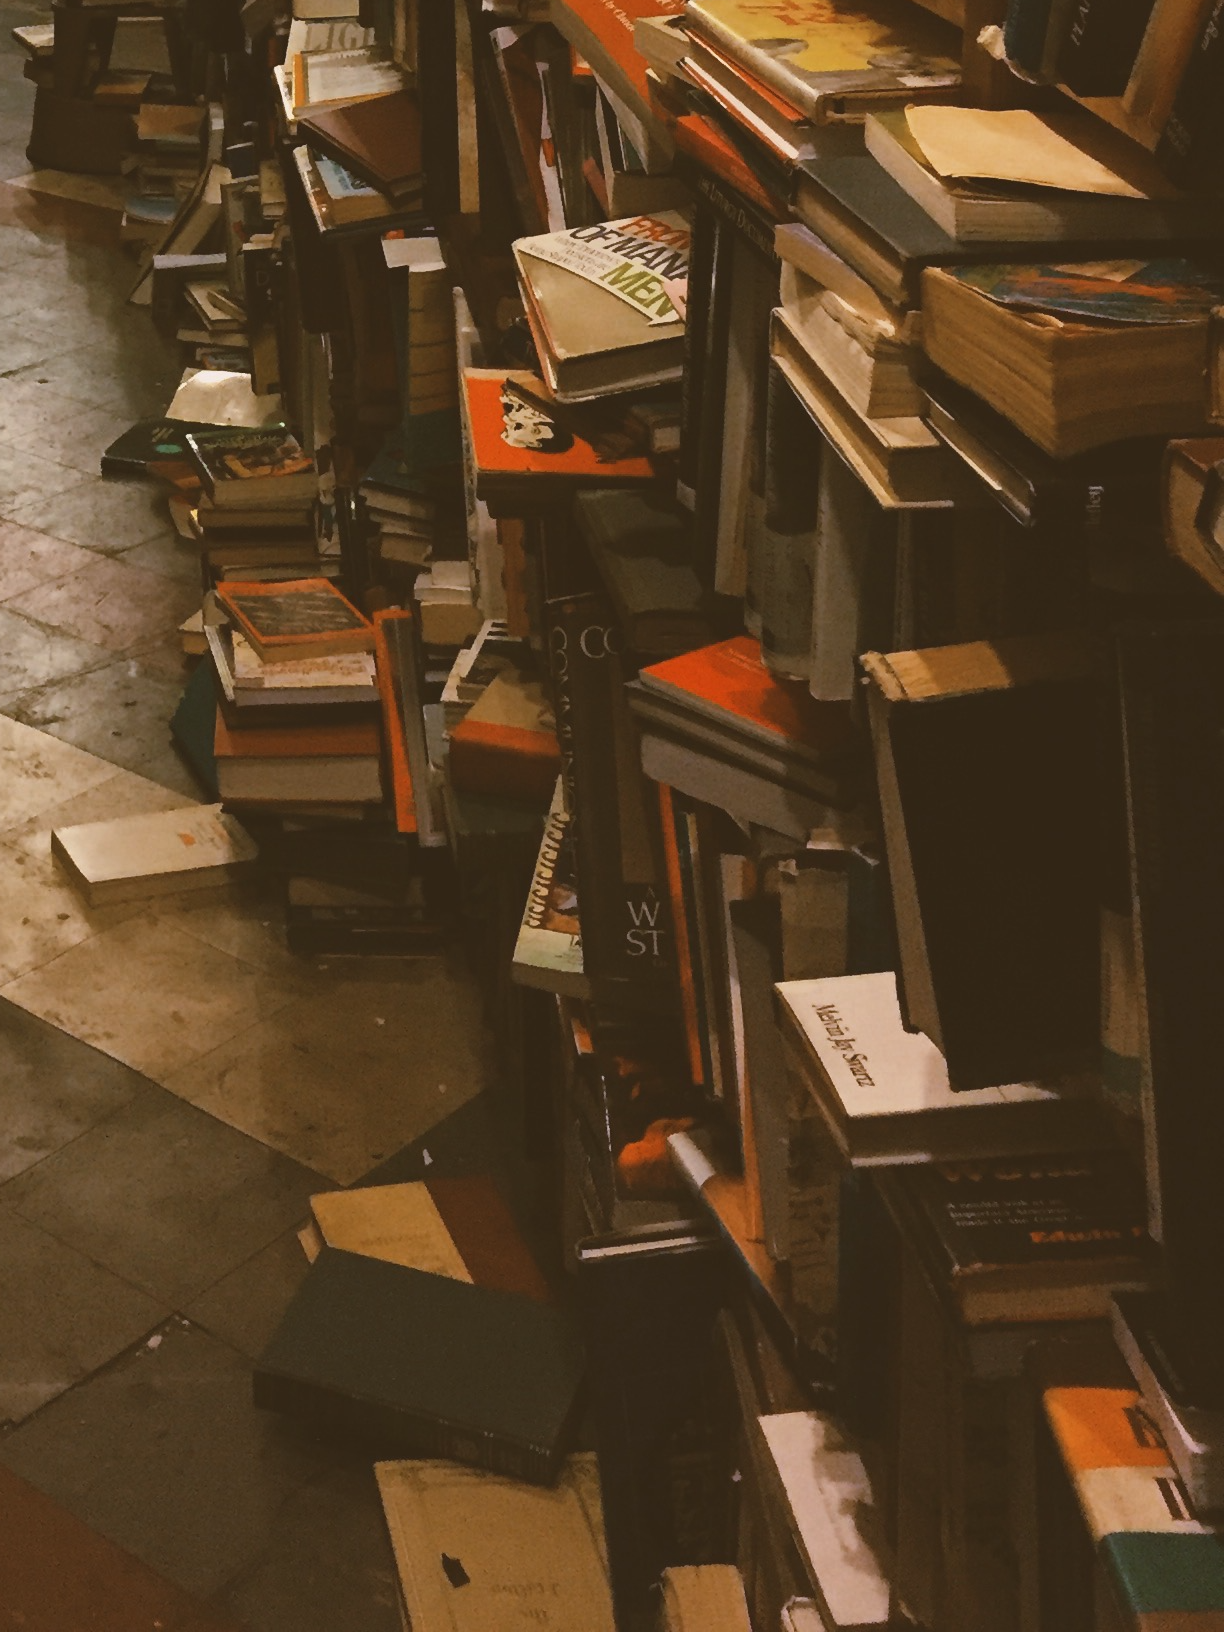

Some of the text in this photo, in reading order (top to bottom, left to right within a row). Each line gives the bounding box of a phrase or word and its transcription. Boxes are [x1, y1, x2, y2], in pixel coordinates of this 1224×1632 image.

[569, 224, 625, 244] OF
[599, 260, 675, 319] MEN
[812, 1003, 876, 1088] Melvin Jay Swartz
